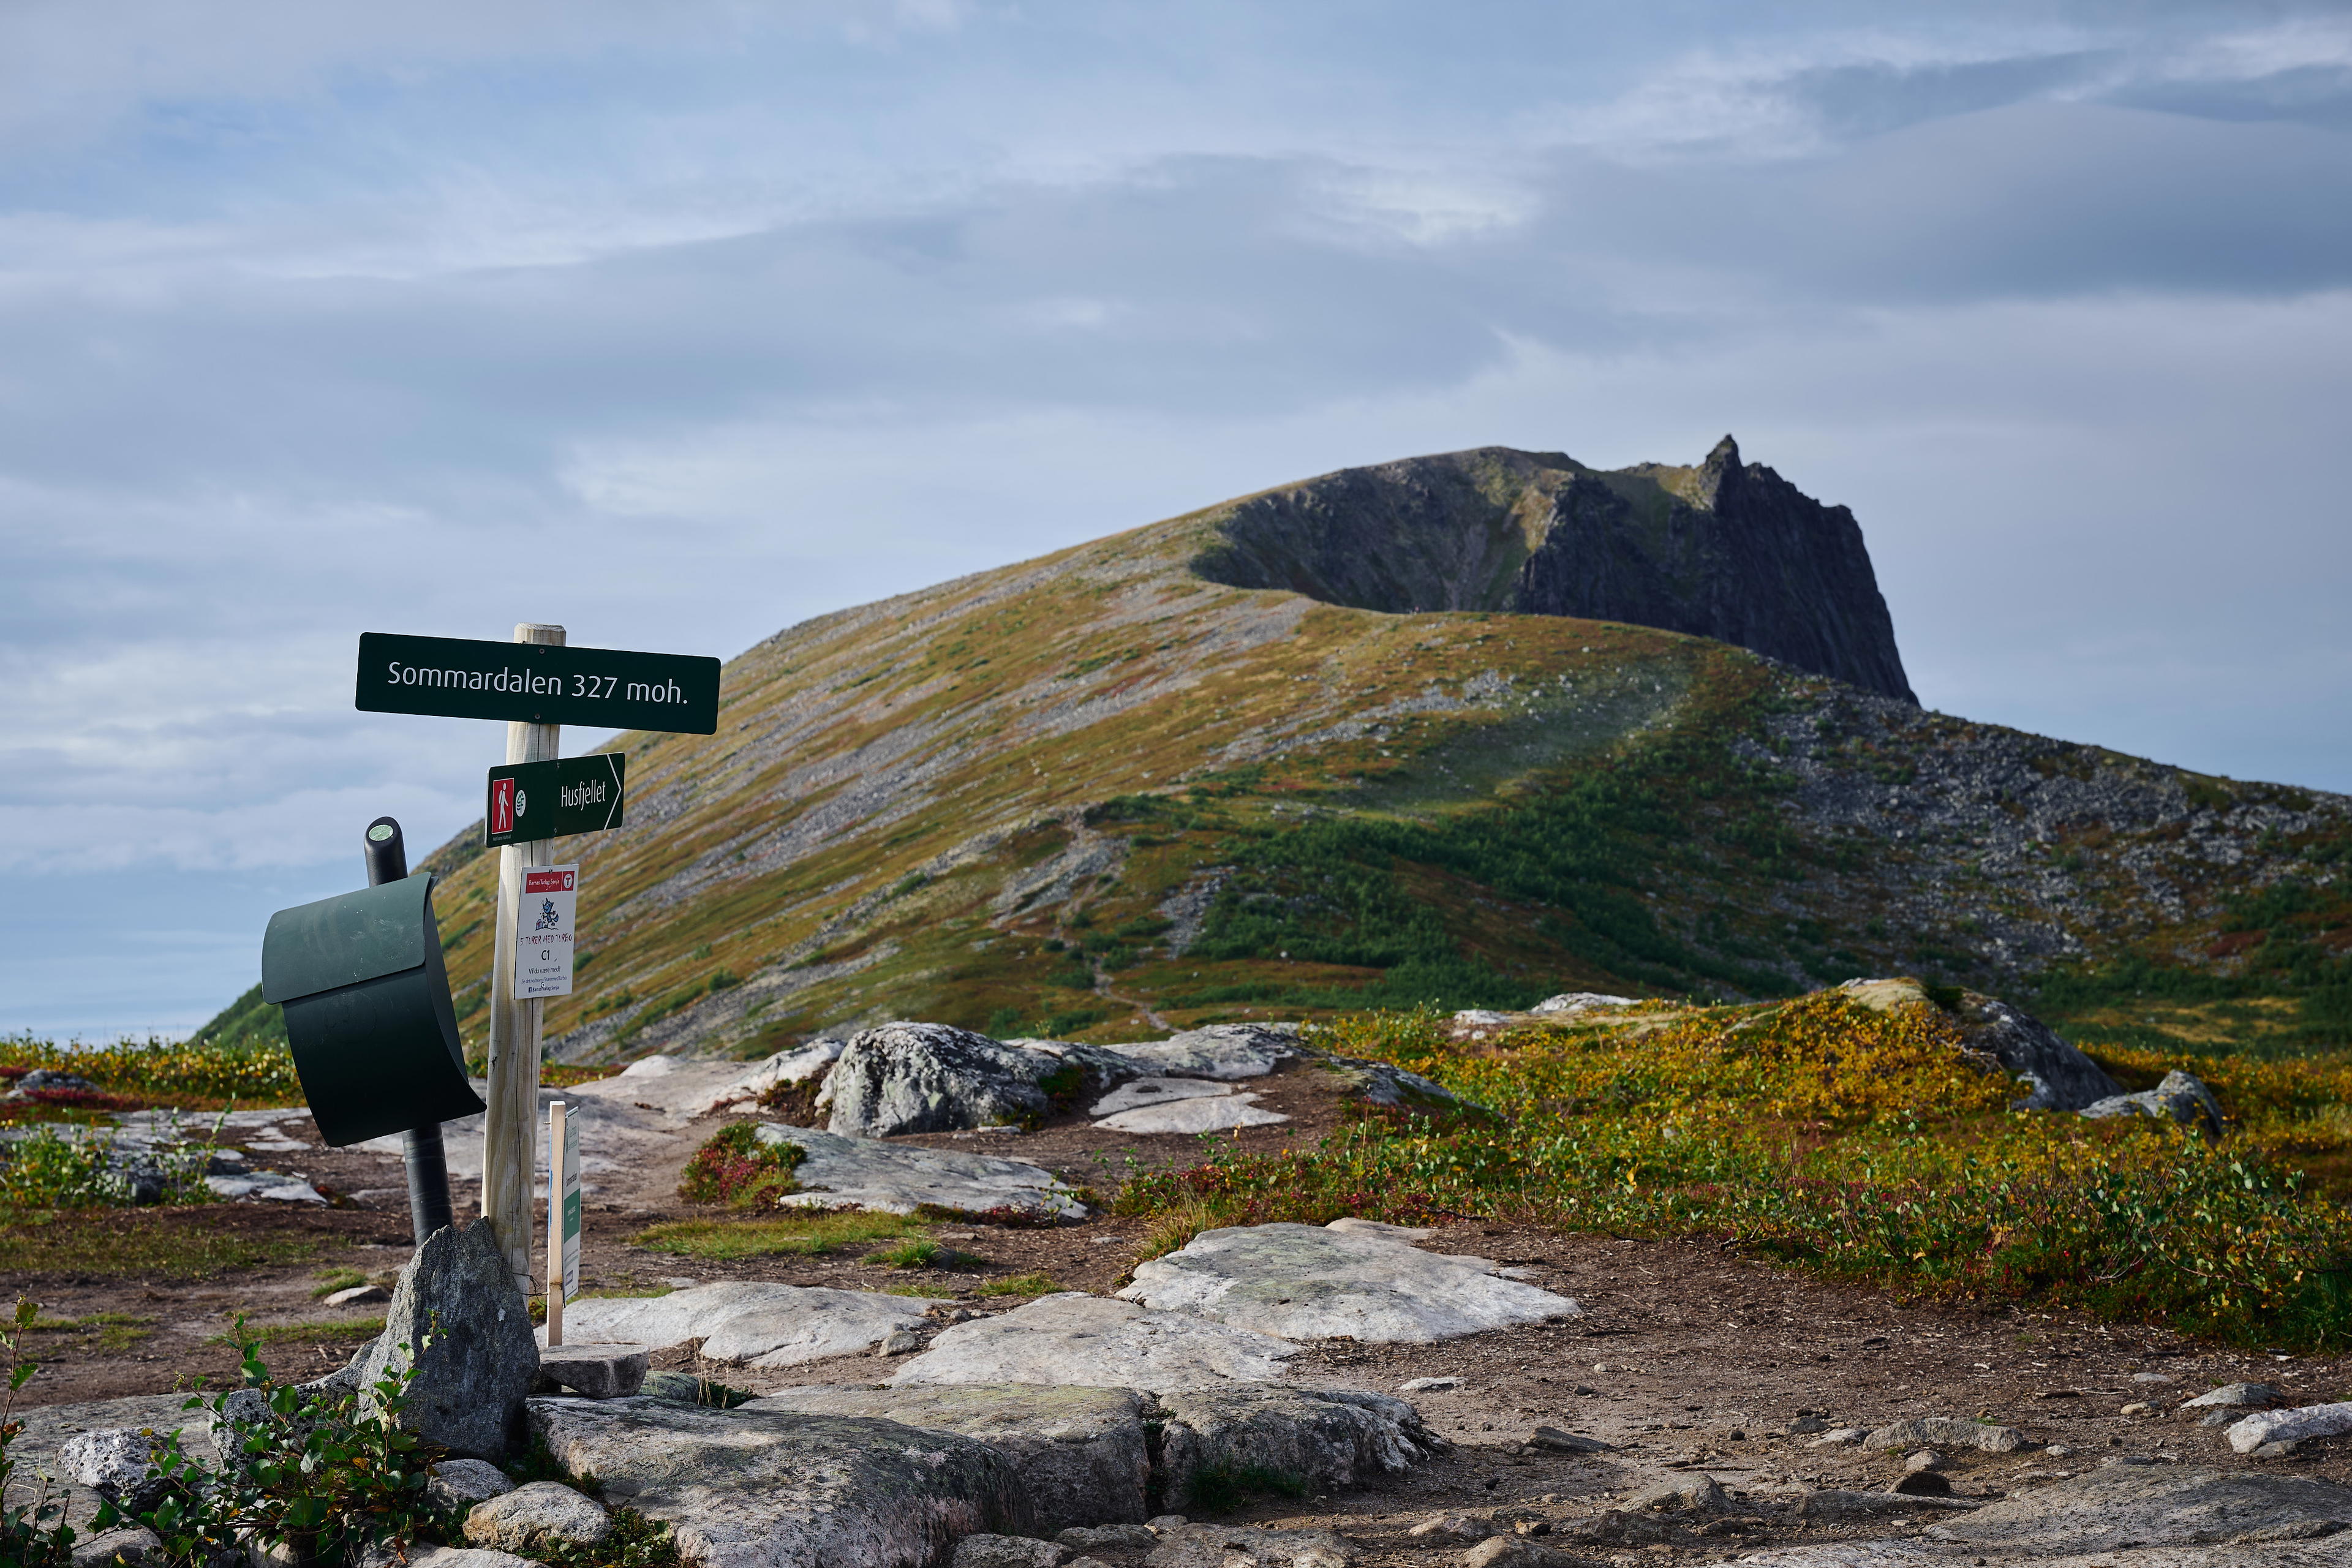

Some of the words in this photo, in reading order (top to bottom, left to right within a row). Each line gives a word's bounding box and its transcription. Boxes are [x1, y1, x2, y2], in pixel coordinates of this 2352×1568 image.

[388, 662, 562, 695] Sommardalen
[571, 674, 618, 699] 327
[627, 678, 688, 704] moh.
[561, 779, 606, 811] Husfjellet
[526, 935, 541, 945] TURER
[543, 935, 554, 944] MED
[556, 933, 572, 942] TURBO
[541, 949, 550, 960] C1
